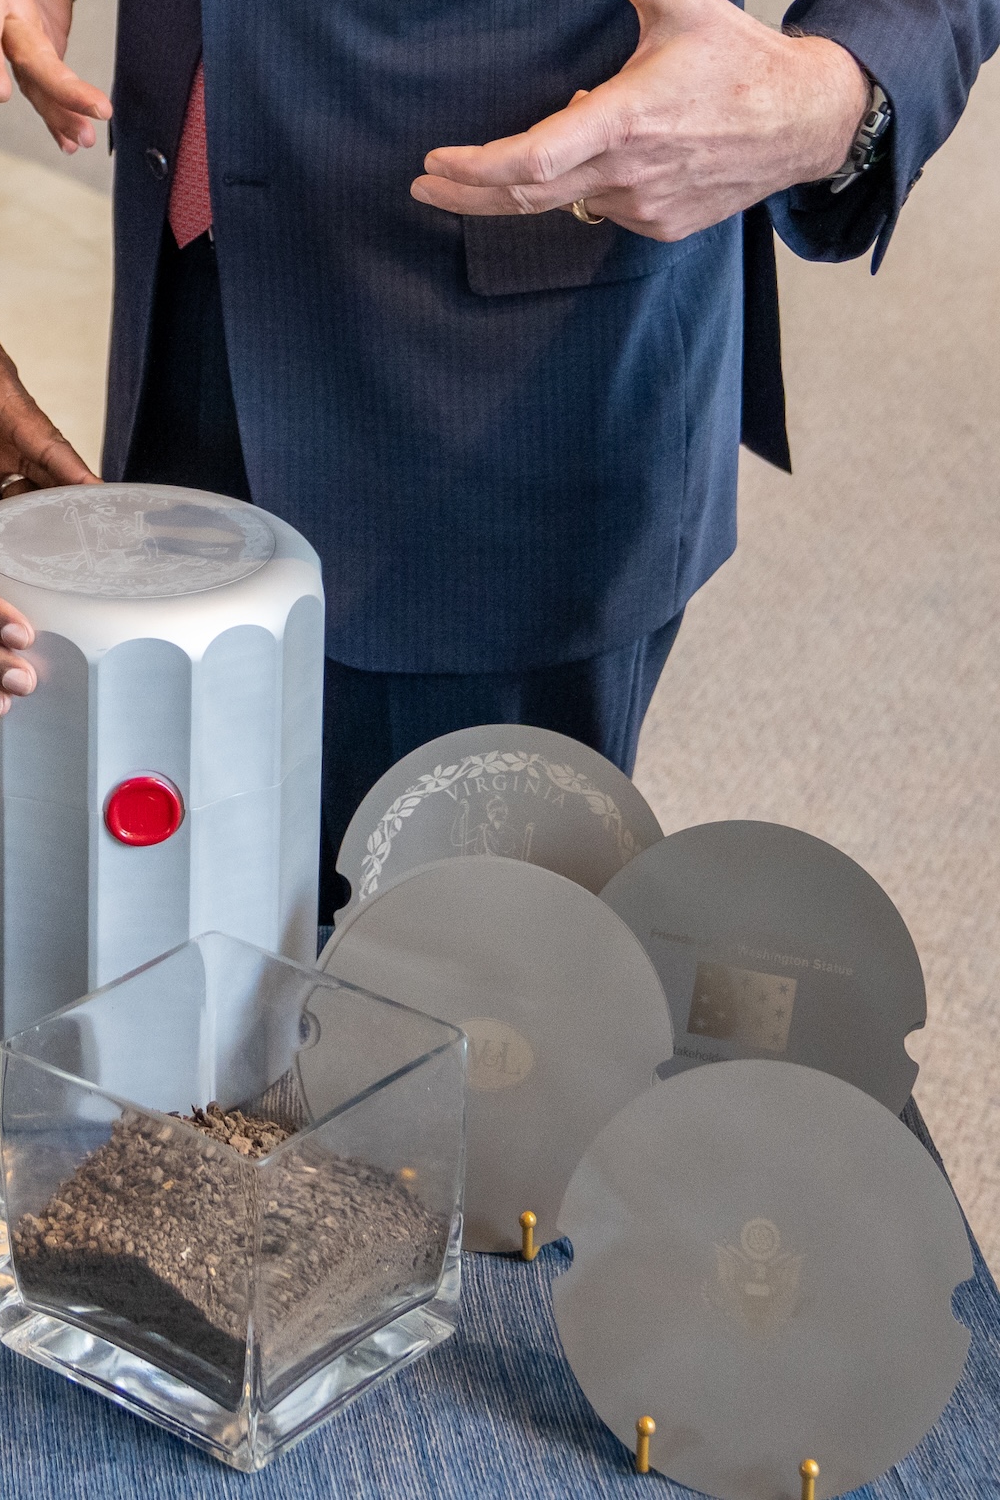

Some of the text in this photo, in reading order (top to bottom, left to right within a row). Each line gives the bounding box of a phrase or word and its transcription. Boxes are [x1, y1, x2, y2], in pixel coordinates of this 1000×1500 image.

[445, 774, 565, 808] VIRGINIA
[736, 943, 810, 969] Washington
[812, 958, 854, 976] Statue
